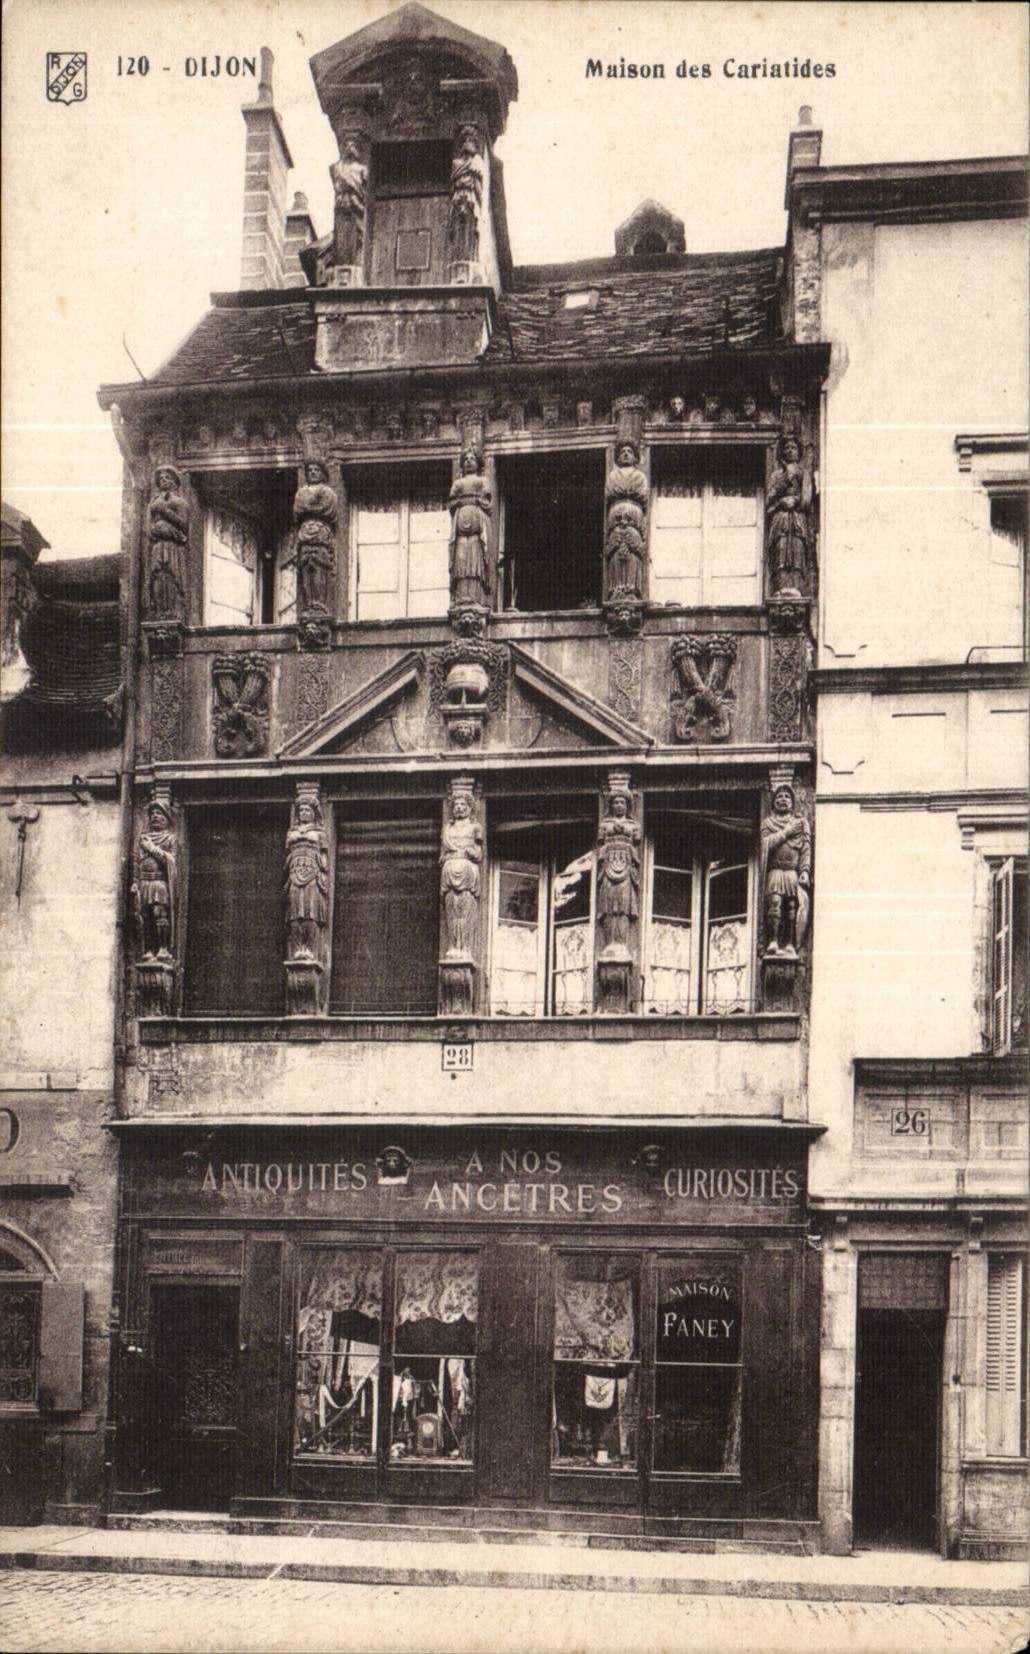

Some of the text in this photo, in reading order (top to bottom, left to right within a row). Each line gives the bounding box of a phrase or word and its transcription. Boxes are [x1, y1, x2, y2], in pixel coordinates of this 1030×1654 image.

[446, 1048, 469, 1066] 28
[894, 1110, 926, 1134] 26
[499, 1148, 563, 1174] NOS
[200, 1157, 368, 1195] ANTIQUITÉS
[663, 1164, 800, 1199] CURIOSITÉS
[668, 1281, 733, 1301] MAISON
[663, 1311, 735, 1339] FANEY
